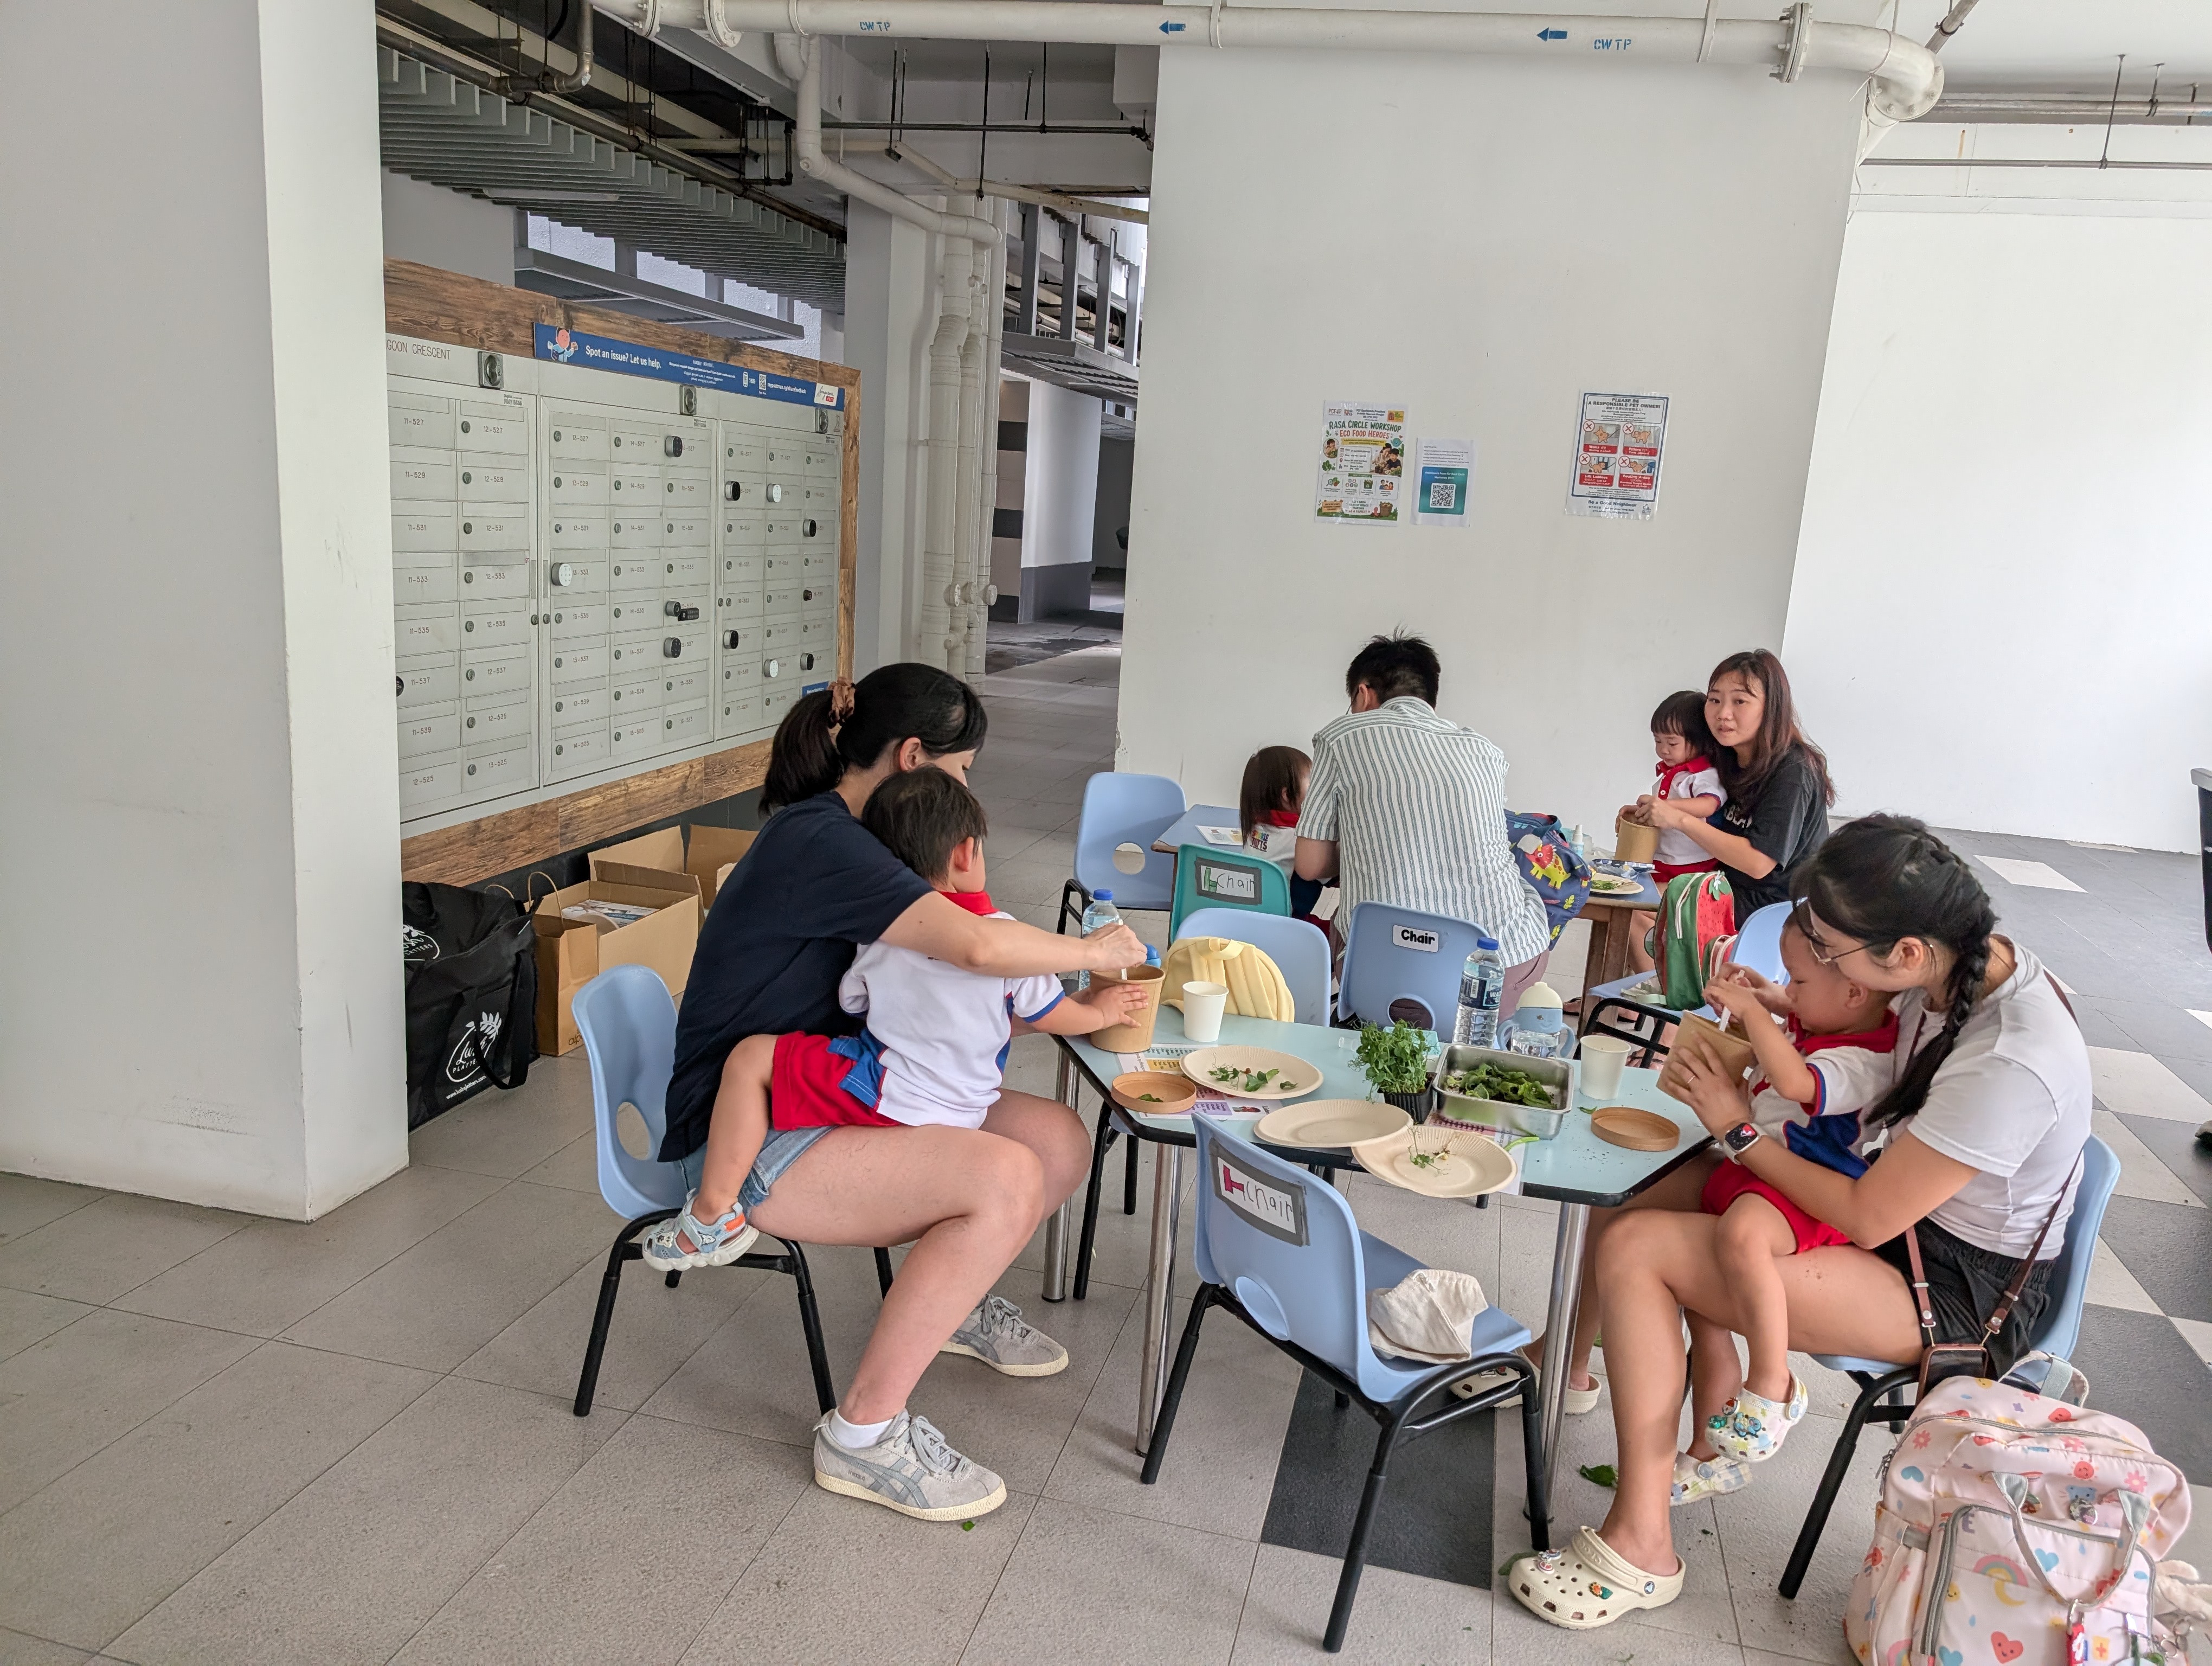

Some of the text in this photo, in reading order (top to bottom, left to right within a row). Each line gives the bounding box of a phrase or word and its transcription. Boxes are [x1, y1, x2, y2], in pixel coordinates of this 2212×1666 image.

[386, 339, 451, 360] GOON CRESCENT
[586, 345, 601, 357] Spot
[610, 350, 629, 362] issue?
[630, 354, 640, 364] Let
[640, 358, 647, 366] us
[648, 356, 662, 370] help.
[404, 418, 424, 426] 11-527
[1329, 420, 1401, 432] RASA CIRCLE WORKSHOP
[1368, 430, 1390, 439] HEROES
[573, 655, 589, 663] 13-537
[411, 677, 430, 685] 11-537
[488, 713, 507, 721] 12-539
[412, 727, 432, 735] 11-539
[488, 759, 507, 768] 13-525
[413, 776, 434, 785] 12-525
[1217, 873, 1255, 892] Chair
[1401, 929, 1435, 945] Chair
[403, 944, 433, 955] LATTERS
[453, 1059, 477, 1073] PLATTE
